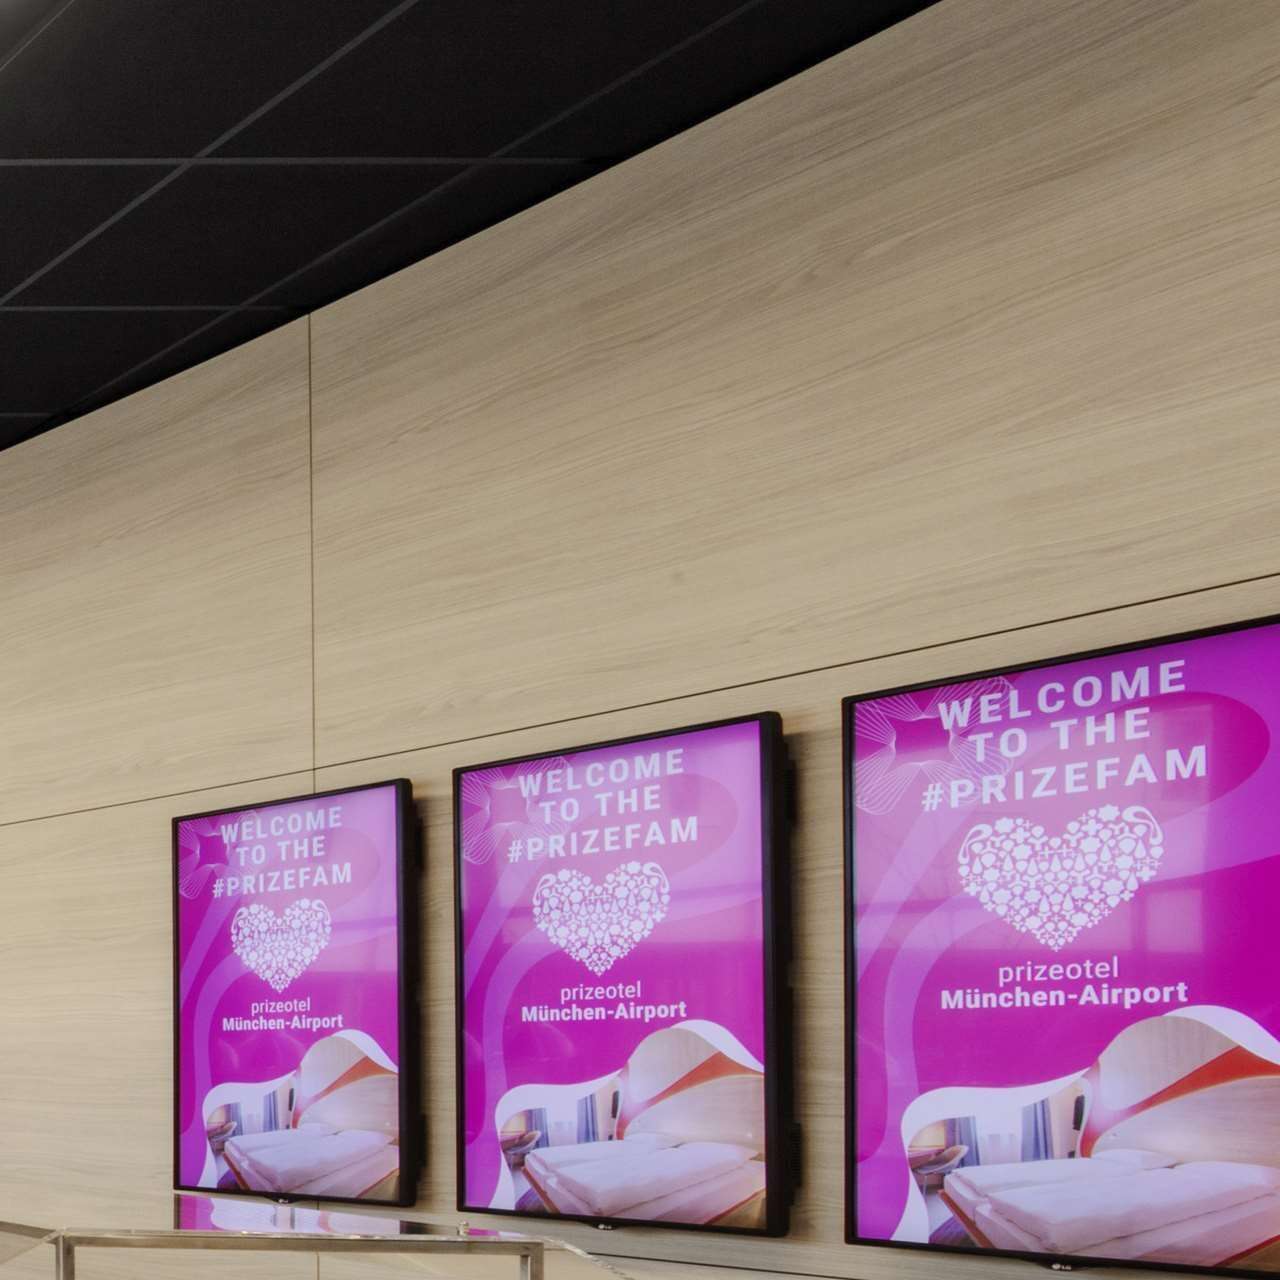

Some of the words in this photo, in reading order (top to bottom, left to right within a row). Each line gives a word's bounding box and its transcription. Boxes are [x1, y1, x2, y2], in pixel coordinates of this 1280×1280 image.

[937, 659, 1186, 731] WELCOME
[967, 727, 1028, 763] TO
[1050, 706, 1151, 750] THE
[518, 748, 684, 798] WELCOME
[921, 744, 1208, 812] #PRIZEFAM
[539, 797, 580, 825] TO
[594, 785, 661, 817] THE
[220, 806, 343, 844] WELCOME
[507, 815, 698, 863] #PRIZEFAM
[236, 844, 266, 867] TO
[277, 835, 325, 861] THE
[213, 862, 352, 898] #PRIZEFAM
[999, 955, 1119, 987] prizeotel
[251, 996, 311, 1016] prizeotel
[560, 980, 641, 1004] prizeotel
[940, 981, 1189, 1009] München-Airport
[222, 1014, 343, 1032] München-Airport
[521, 1000, 687, 1022] München-Airport
